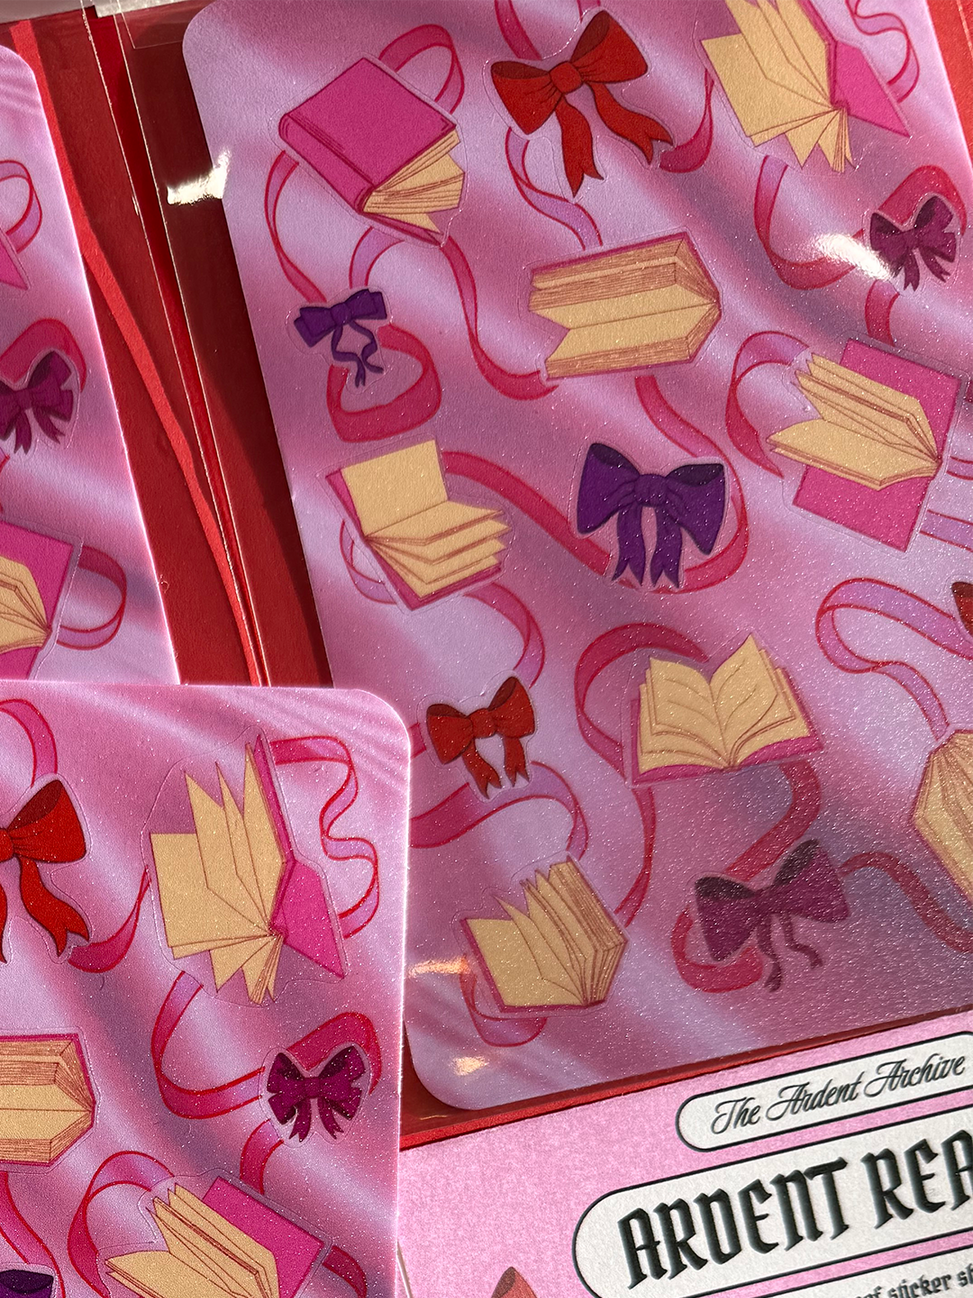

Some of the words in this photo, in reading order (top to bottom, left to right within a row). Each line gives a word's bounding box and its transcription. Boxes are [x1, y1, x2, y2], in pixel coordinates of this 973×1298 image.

[711, 1096, 761, 1135] The
[765, 1071, 869, 1121] Ardent
[864, 1052, 966, 1098] Archive
[617, 1156, 850, 1290] ARDENT
